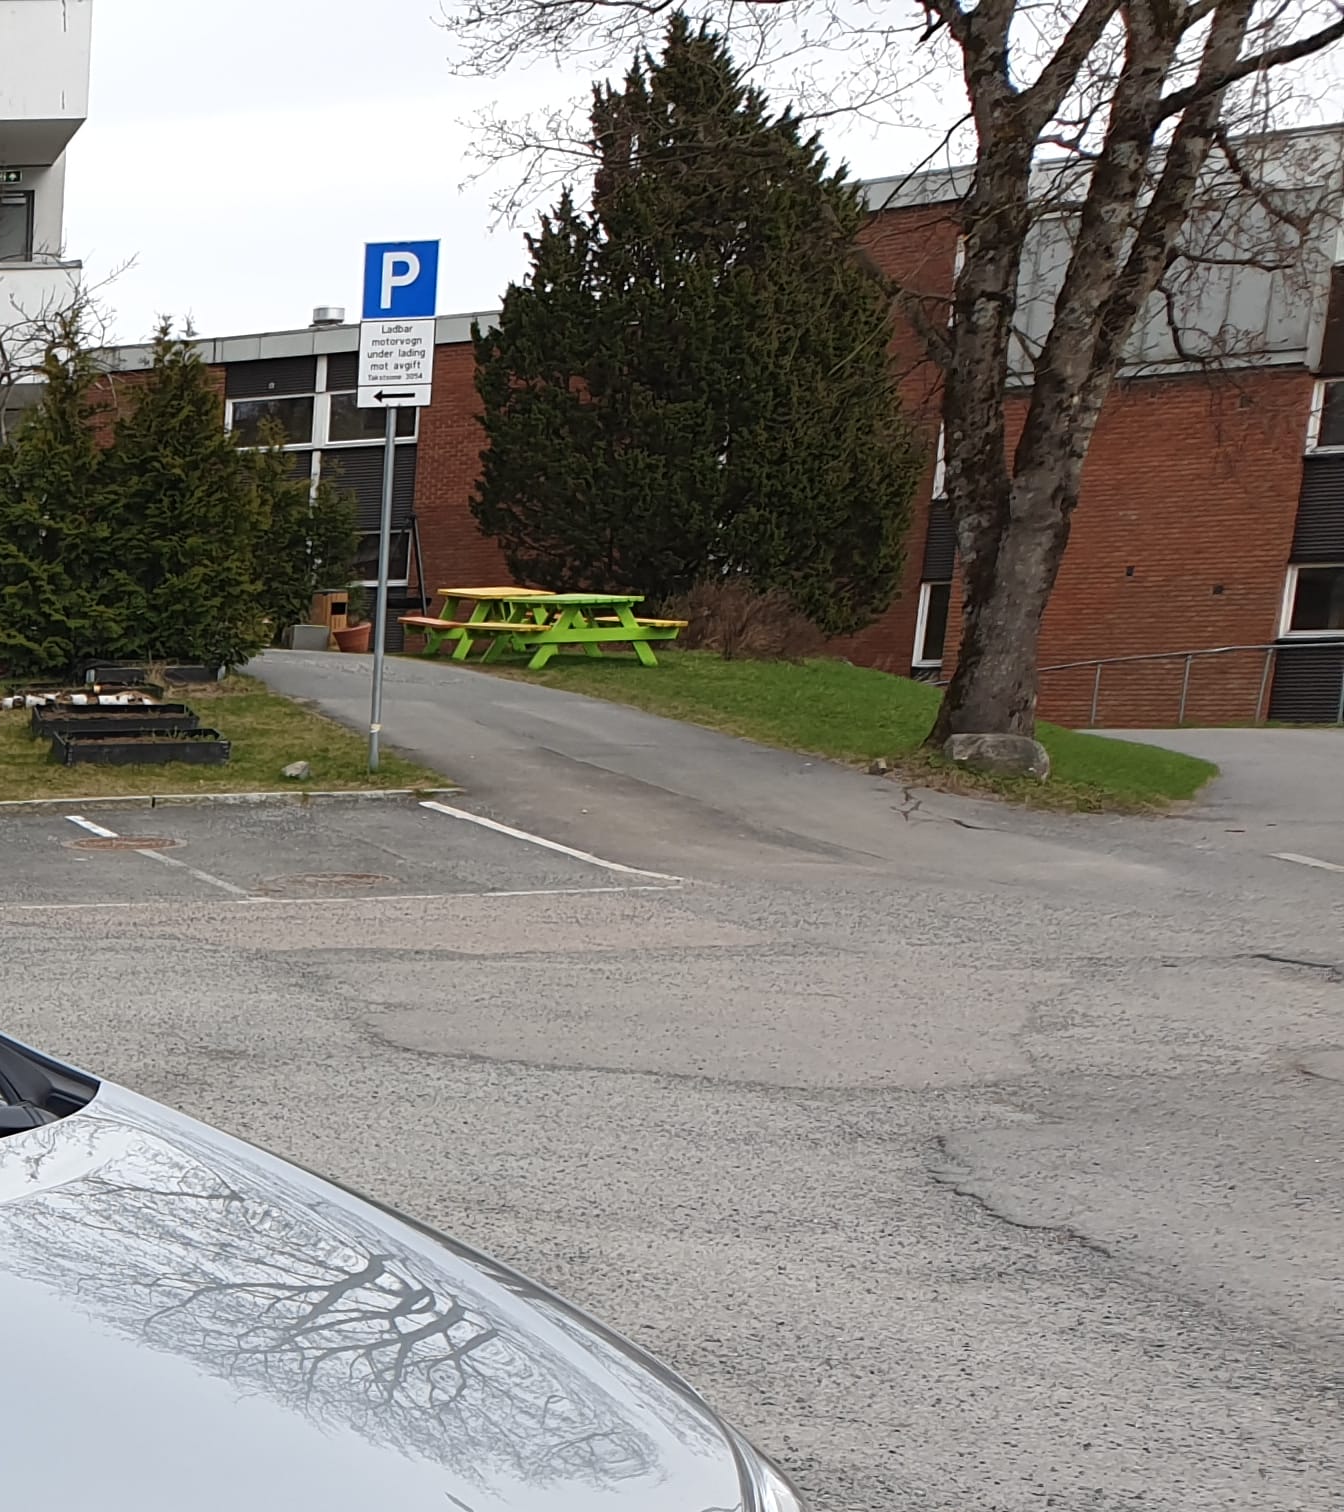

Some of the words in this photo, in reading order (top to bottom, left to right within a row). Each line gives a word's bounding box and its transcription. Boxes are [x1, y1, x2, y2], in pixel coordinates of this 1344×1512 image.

[380, 251, 420, 309] P
[382, 325, 413, 334] Ladbar
[372, 338, 422, 346] motorvogn
[367, 350, 393, 359] under
[398, 349, 426, 359] lading
[370, 362, 388, 371] mot
[393, 360, 421, 371] avgift
